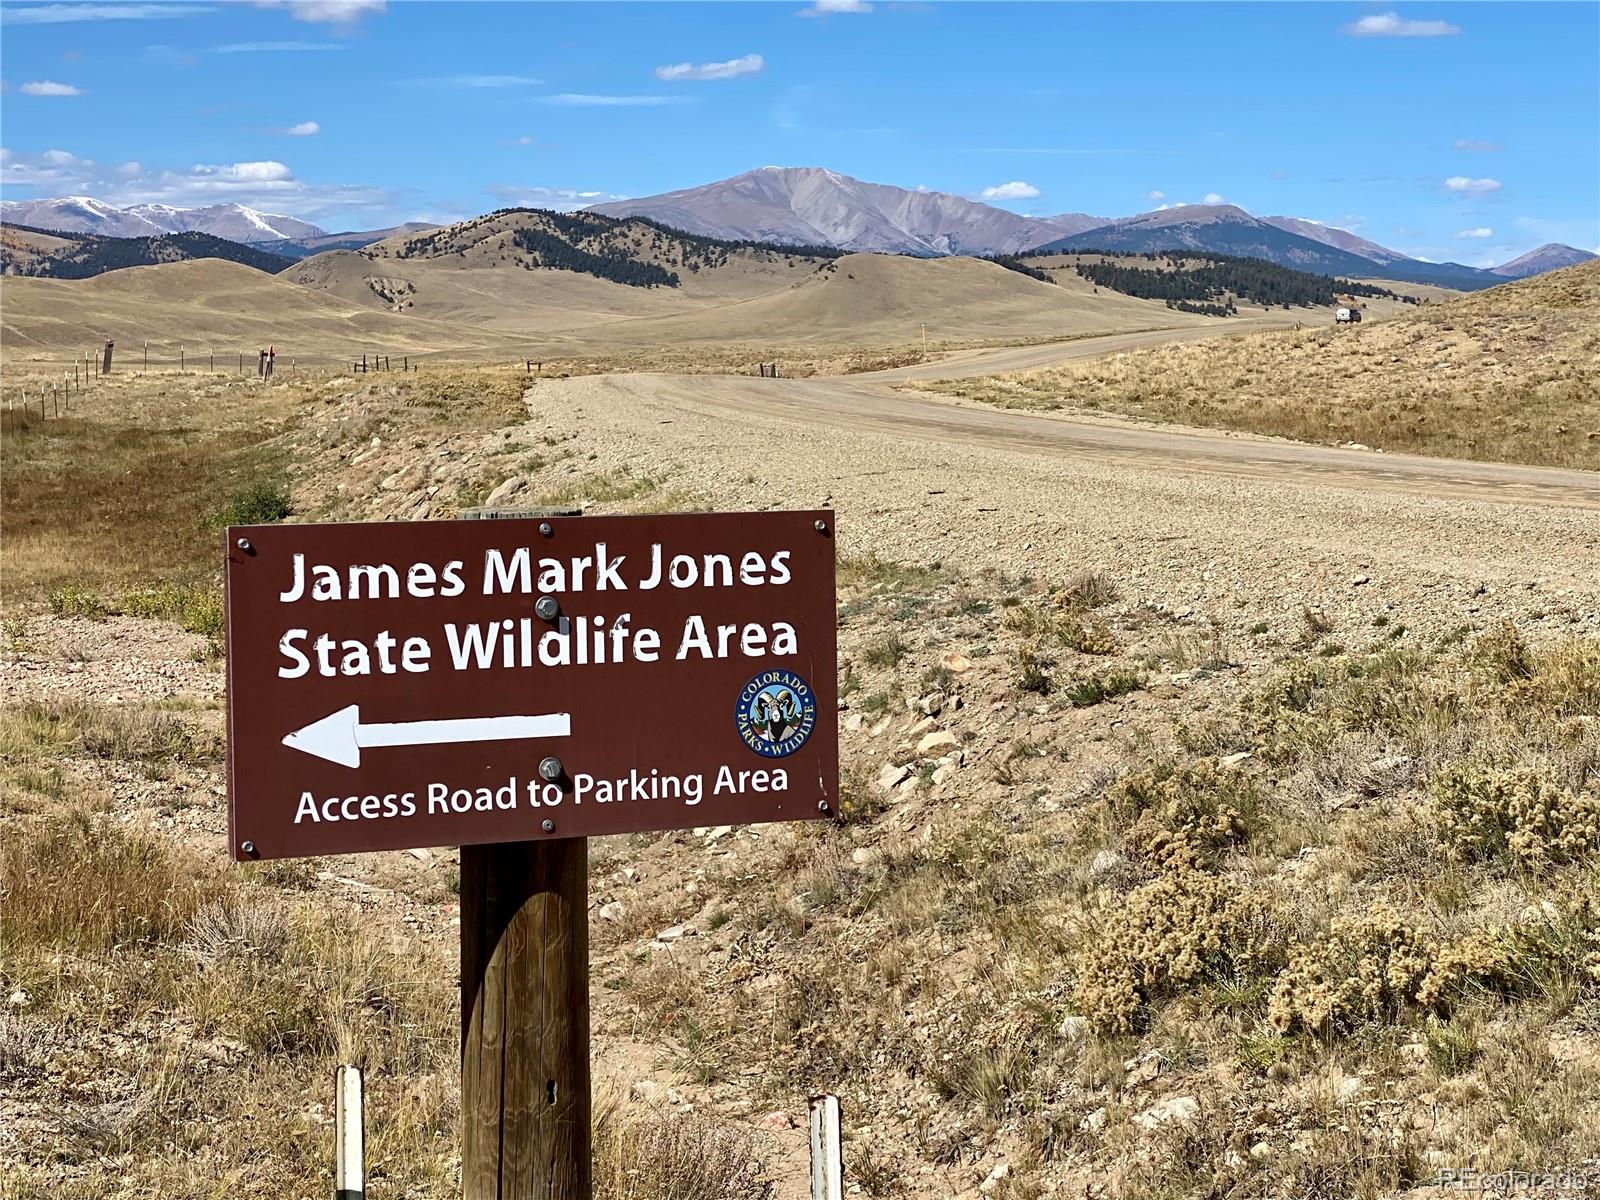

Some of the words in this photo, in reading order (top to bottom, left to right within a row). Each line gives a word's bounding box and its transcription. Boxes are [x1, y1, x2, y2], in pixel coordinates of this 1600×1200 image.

[280, 553, 465, 603] James
[482, 542, 627, 595] Mark
[638, 543, 792, 590] Jones
[278, 629, 432, 679] State
[444, 613, 661, 671] Wildlife
[675, 615, 798, 661] Area
[742, 672, 807, 702] COLORADO
[738, 713, 763, 751] PARKS
[771, 705, 814, 755] WILDLIFE
[294, 791, 416, 823] Access
[428, 777, 517, 814] Road
[527, 780, 563, 806] to
[574, 768, 702, 805] Parking
[713, 765, 789, 794] Area
